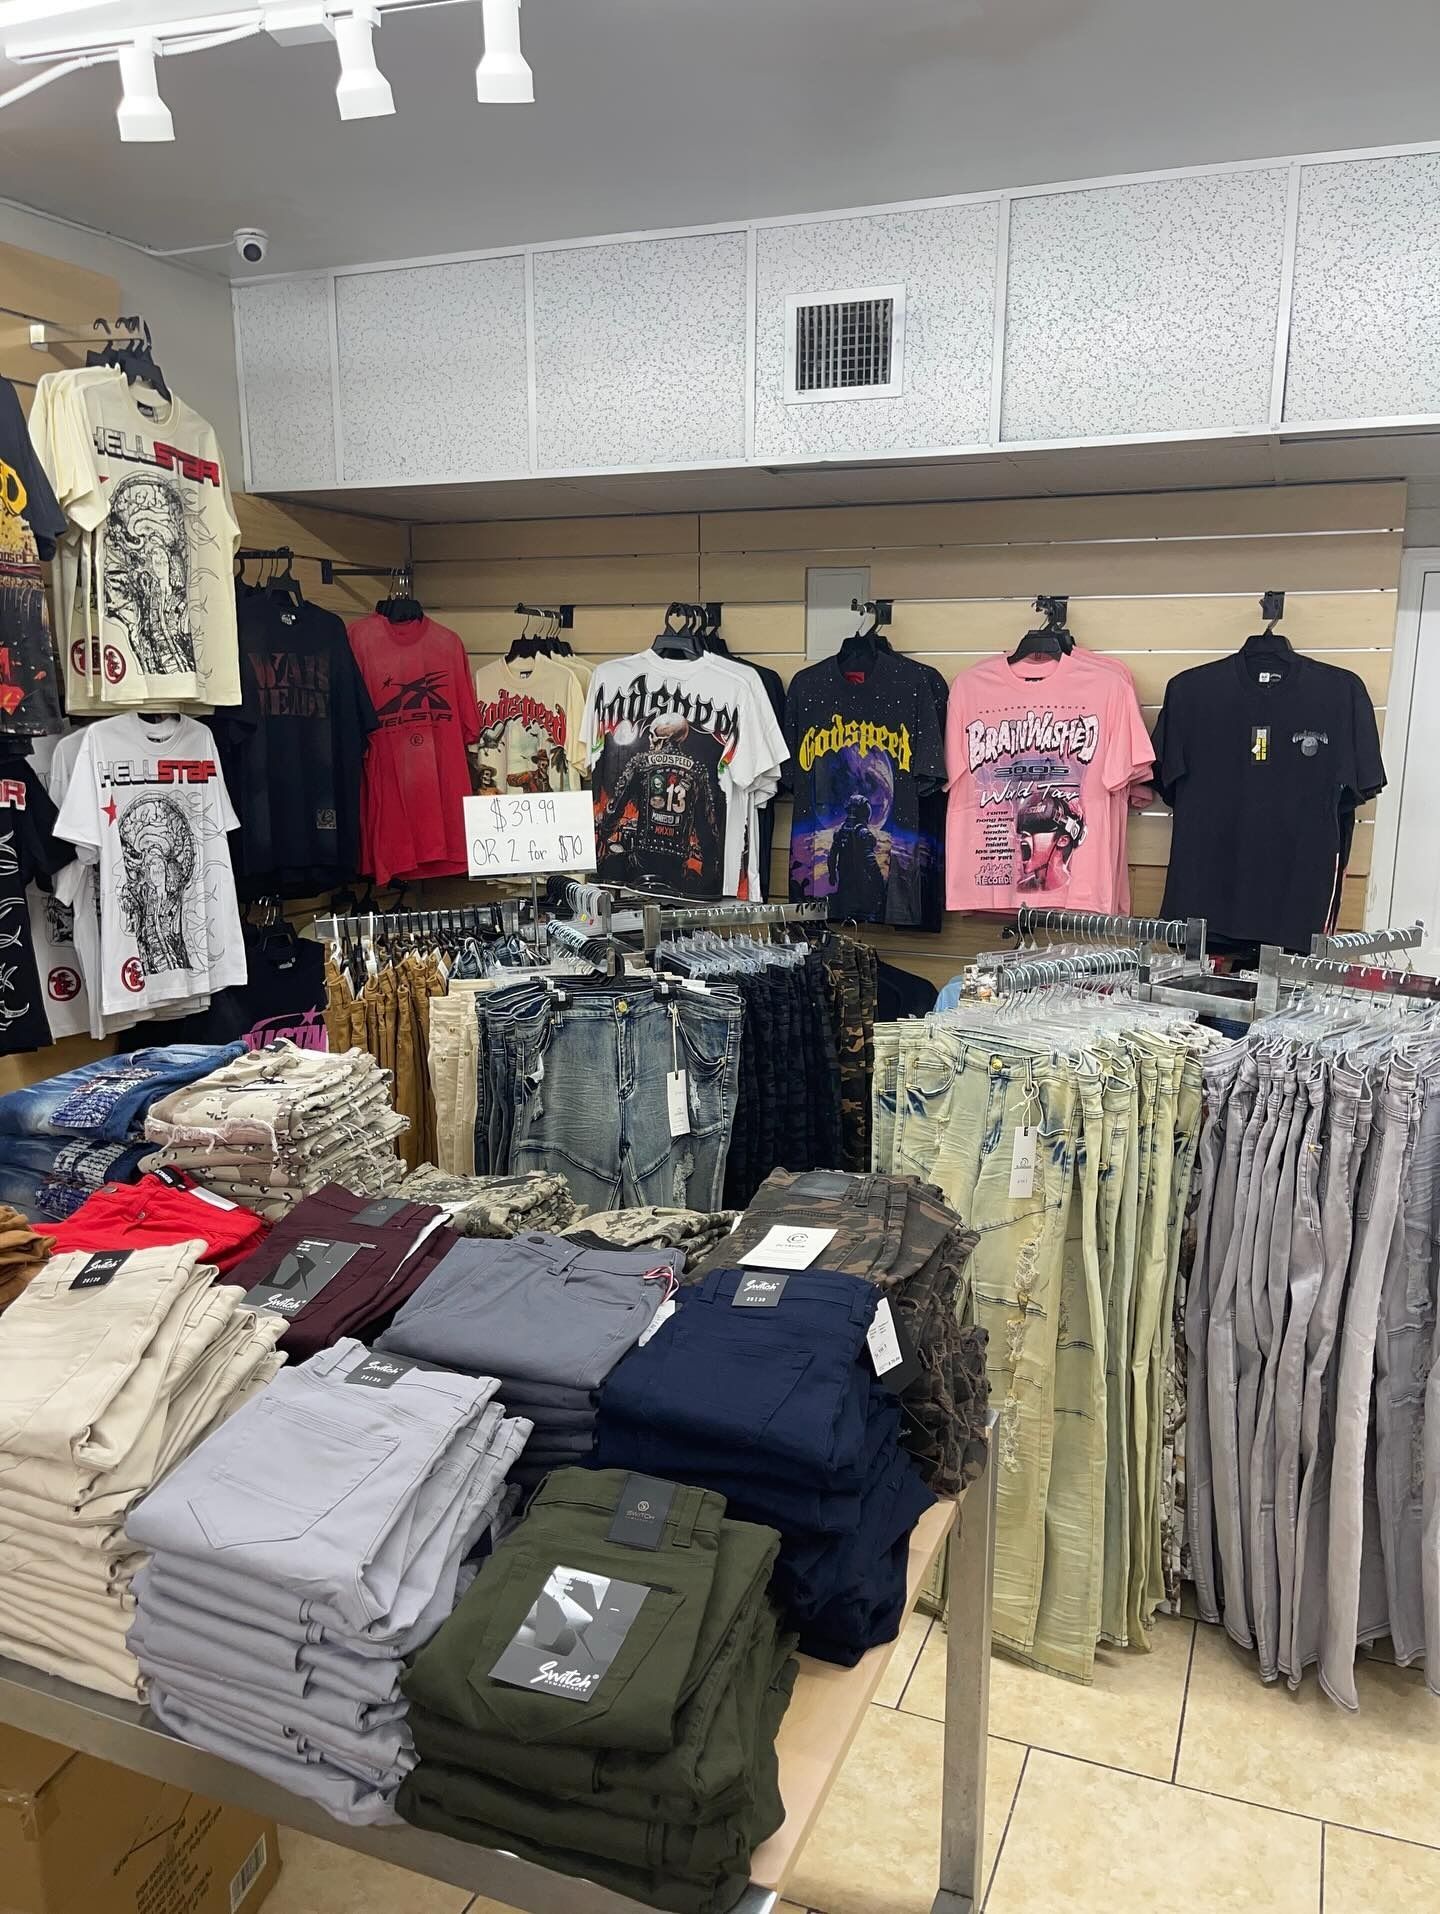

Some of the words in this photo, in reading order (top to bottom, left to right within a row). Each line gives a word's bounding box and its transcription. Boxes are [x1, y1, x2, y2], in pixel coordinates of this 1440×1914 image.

[799, 713, 913, 773] Godspeed
[651, 755, 692, 768] GODSPEED
[666, 783, 686, 814] 13
[472, 838, 500, 866] OR
[507, 838, 521, 862] 2
[528, 839, 548, 861] for
[559, 834, 583, 863] $70
[529, 1660, 592, 1689] Switch
